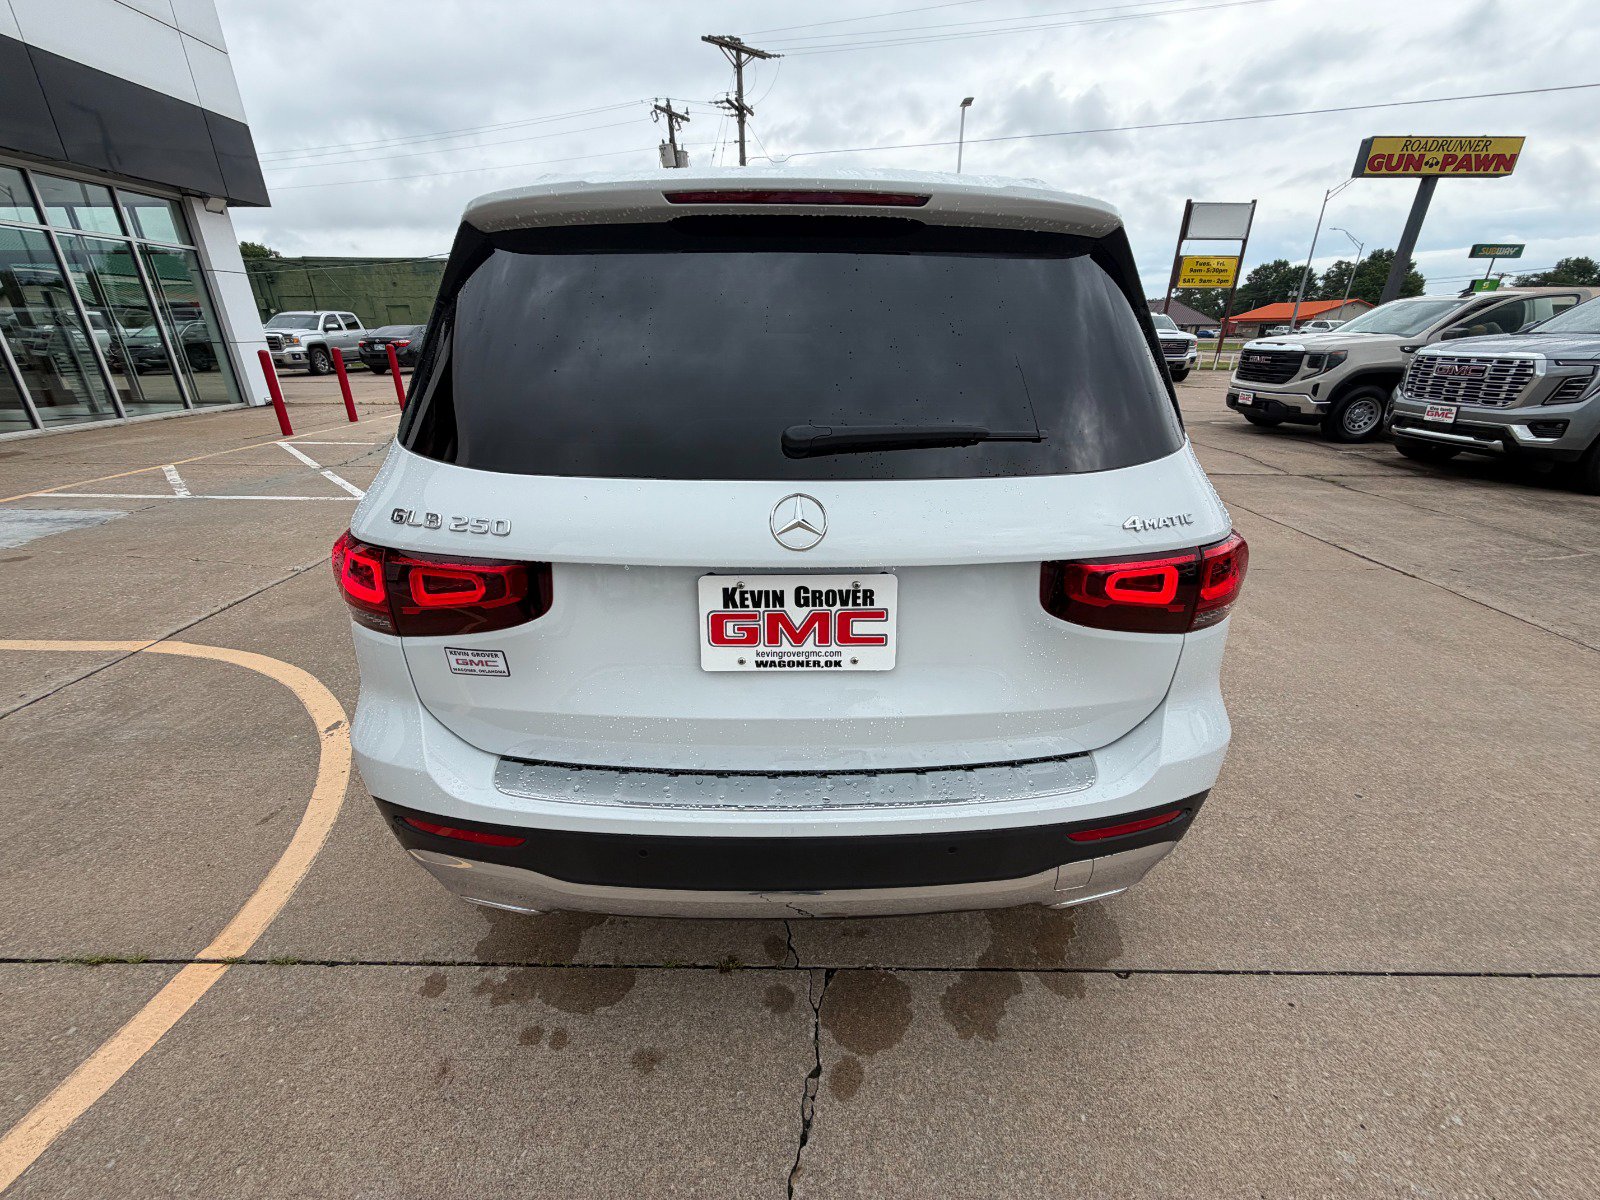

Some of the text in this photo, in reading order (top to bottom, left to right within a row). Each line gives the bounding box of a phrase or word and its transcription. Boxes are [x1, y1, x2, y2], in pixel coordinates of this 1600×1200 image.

[1401, 139, 1492, 152] ROADRUNNER
[1367, 153, 1518, 172] GUN PAWN
[1478, 247, 1516, 255] SUBWAY
[1436, 365, 1485, 376] GMC
[1426, 410, 1453, 418] GMC
[391, 508, 511, 537] GLB 250
[1122, 514, 1194, 533] 4MATIC
[722, 585, 875, 609] KEVIN GROVER
[707, 608, 888, 647] GMC
[755, 649, 842, 660] kevingrovergmc.com
[455, 658, 499, 667] GMC
